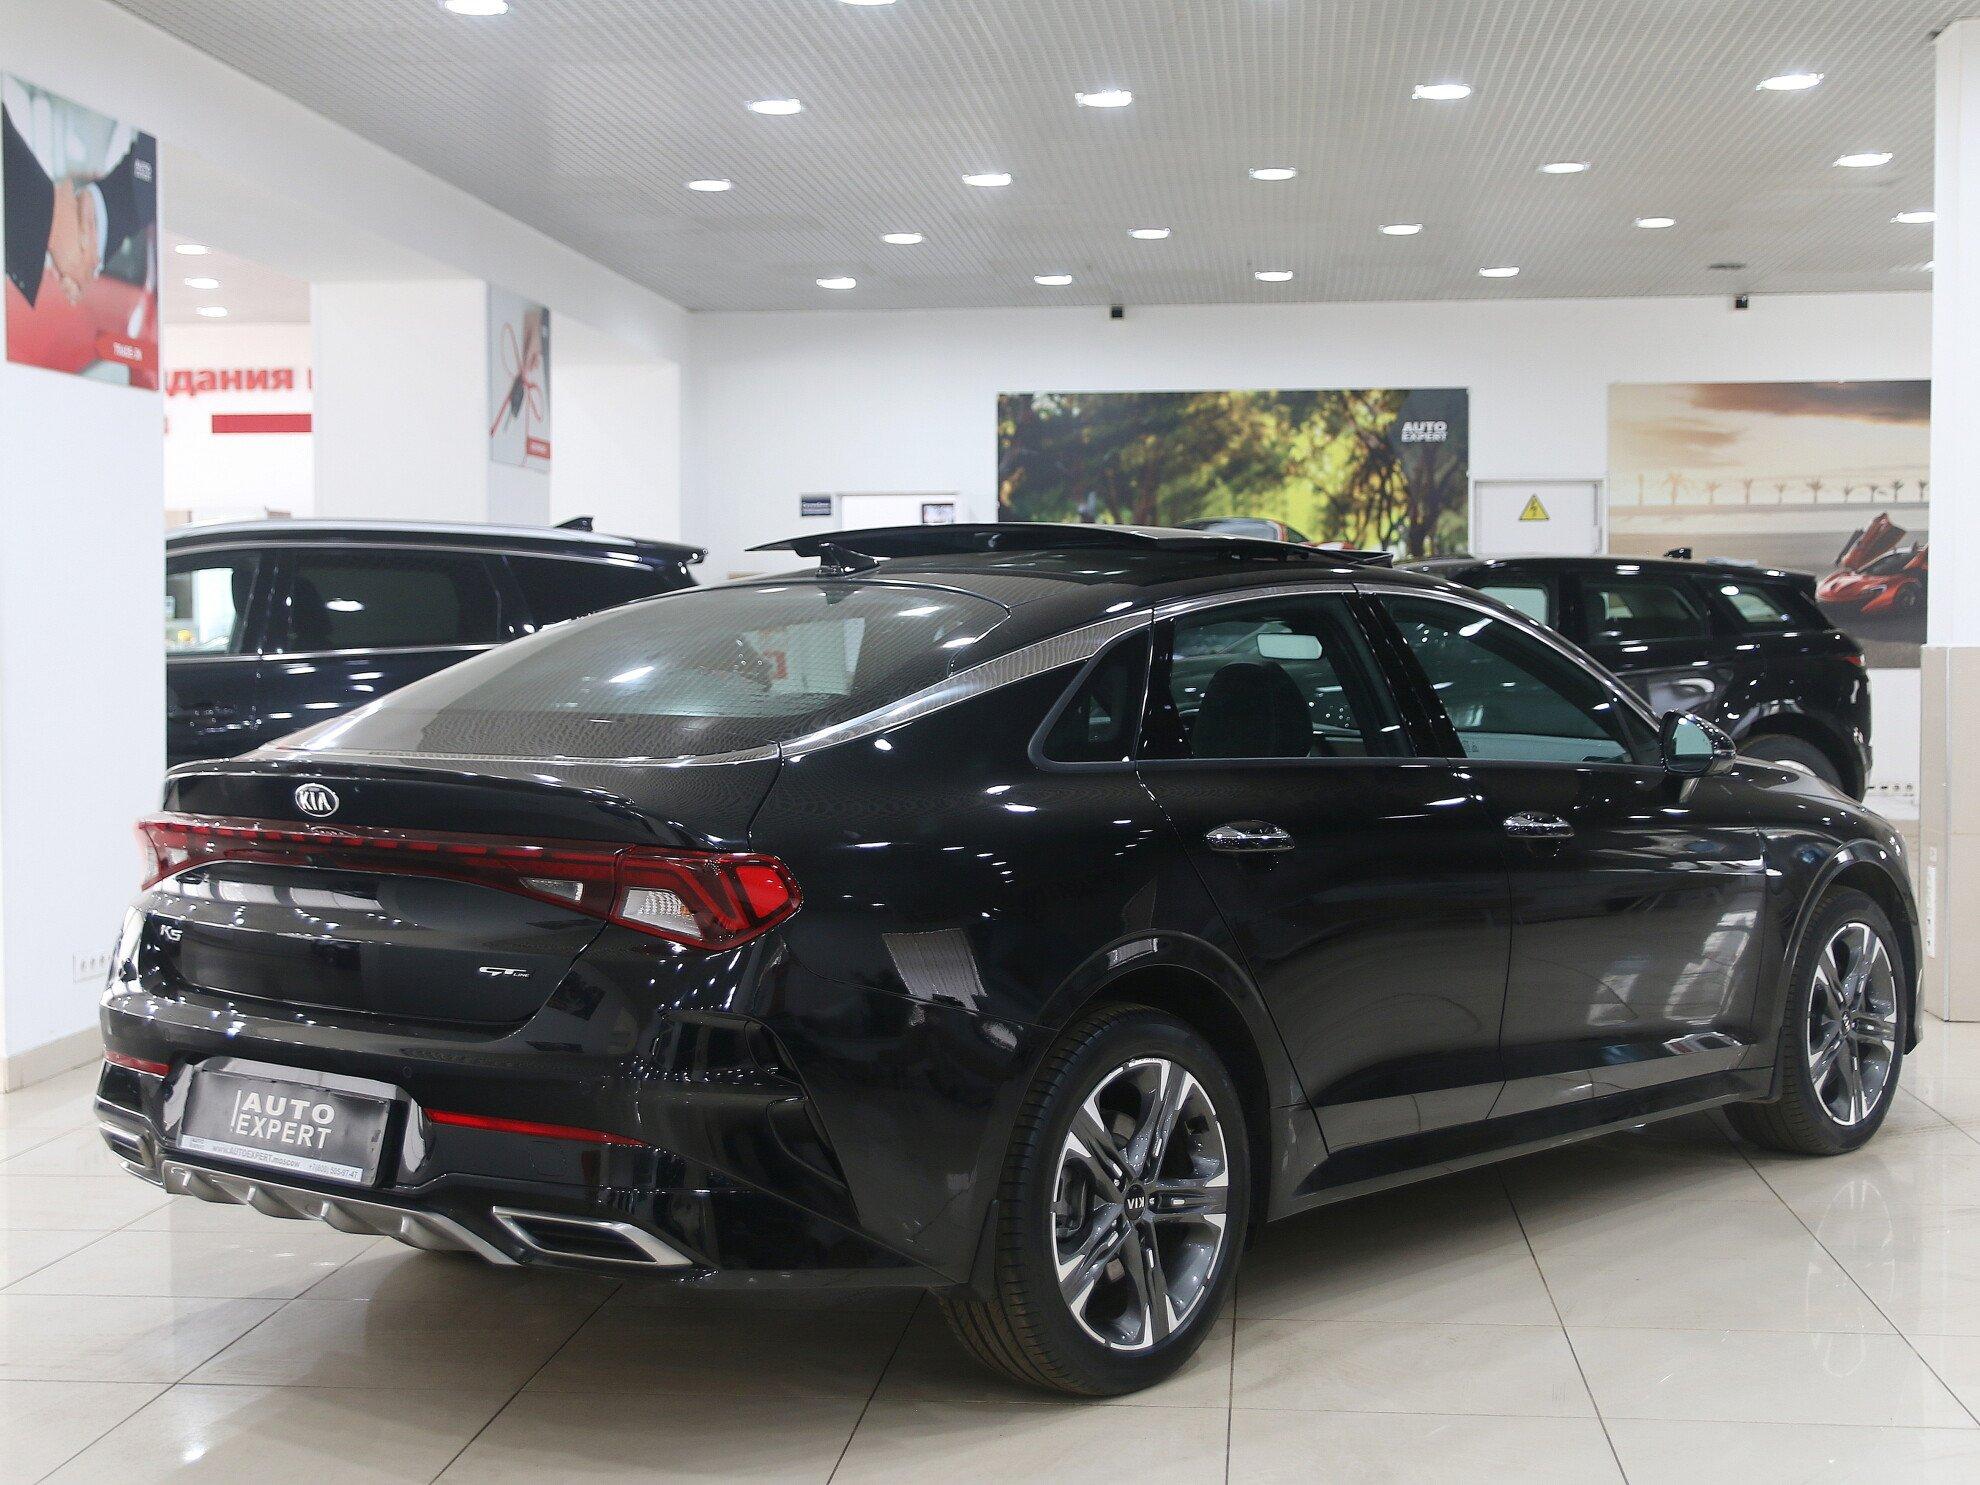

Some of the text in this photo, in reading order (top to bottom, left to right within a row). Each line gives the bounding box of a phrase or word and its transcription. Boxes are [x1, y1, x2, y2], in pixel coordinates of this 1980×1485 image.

[165, 368, 294, 397] дания
[1402, 421, 1447, 433] AUTO
[300, 790, 333, 811] KIA
[479, 966, 527, 976] GT
[241, 1093, 335, 1125] AUTO
[236, 1113, 332, 1149] EXPERT
[1127, 1196, 1145, 1210] KIA
